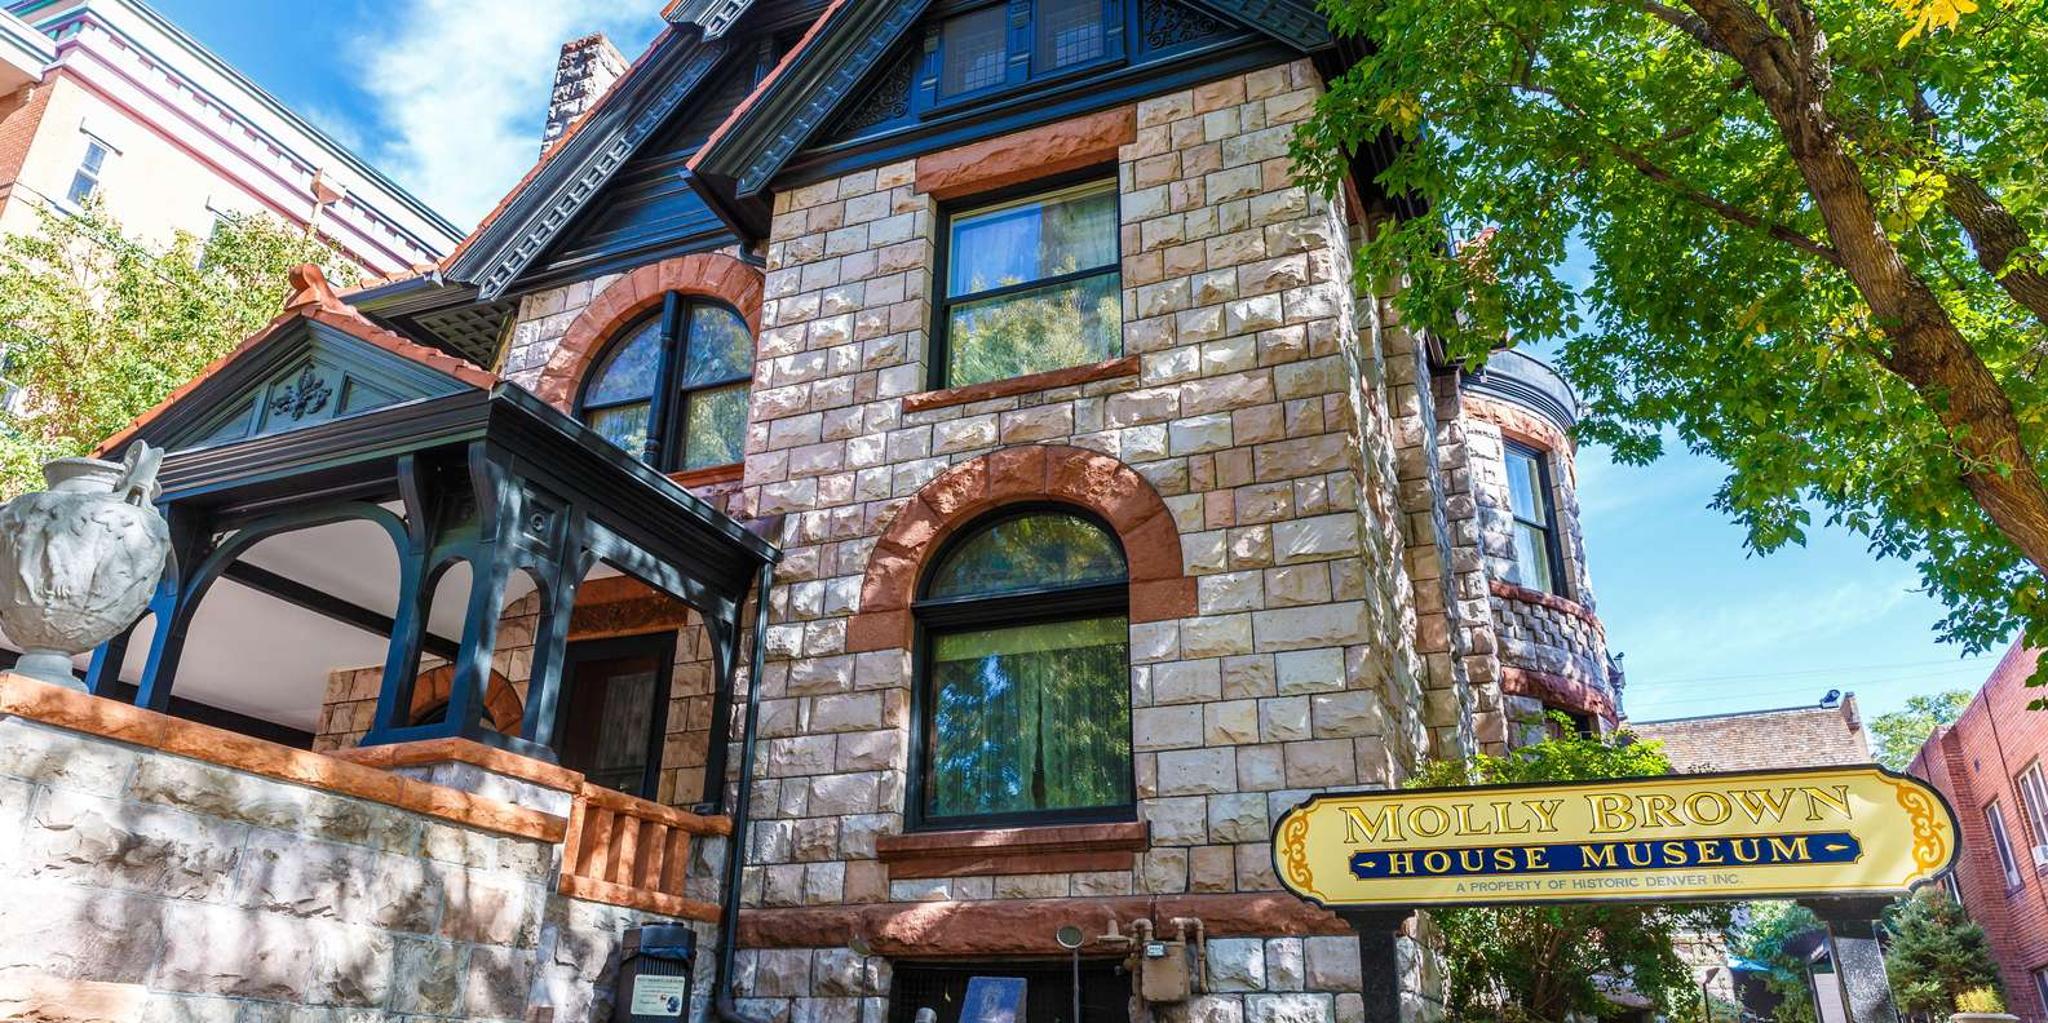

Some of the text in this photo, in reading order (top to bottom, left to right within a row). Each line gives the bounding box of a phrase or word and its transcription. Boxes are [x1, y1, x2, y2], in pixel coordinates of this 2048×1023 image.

[1338, 785, 1853, 844] MOLLY BROWN
[1388, 837, 1812, 875] HOUSE MUSEUM
[1456, 873, 1744, 893] A PROPERTY OF HISTORIC DENVER INC.
